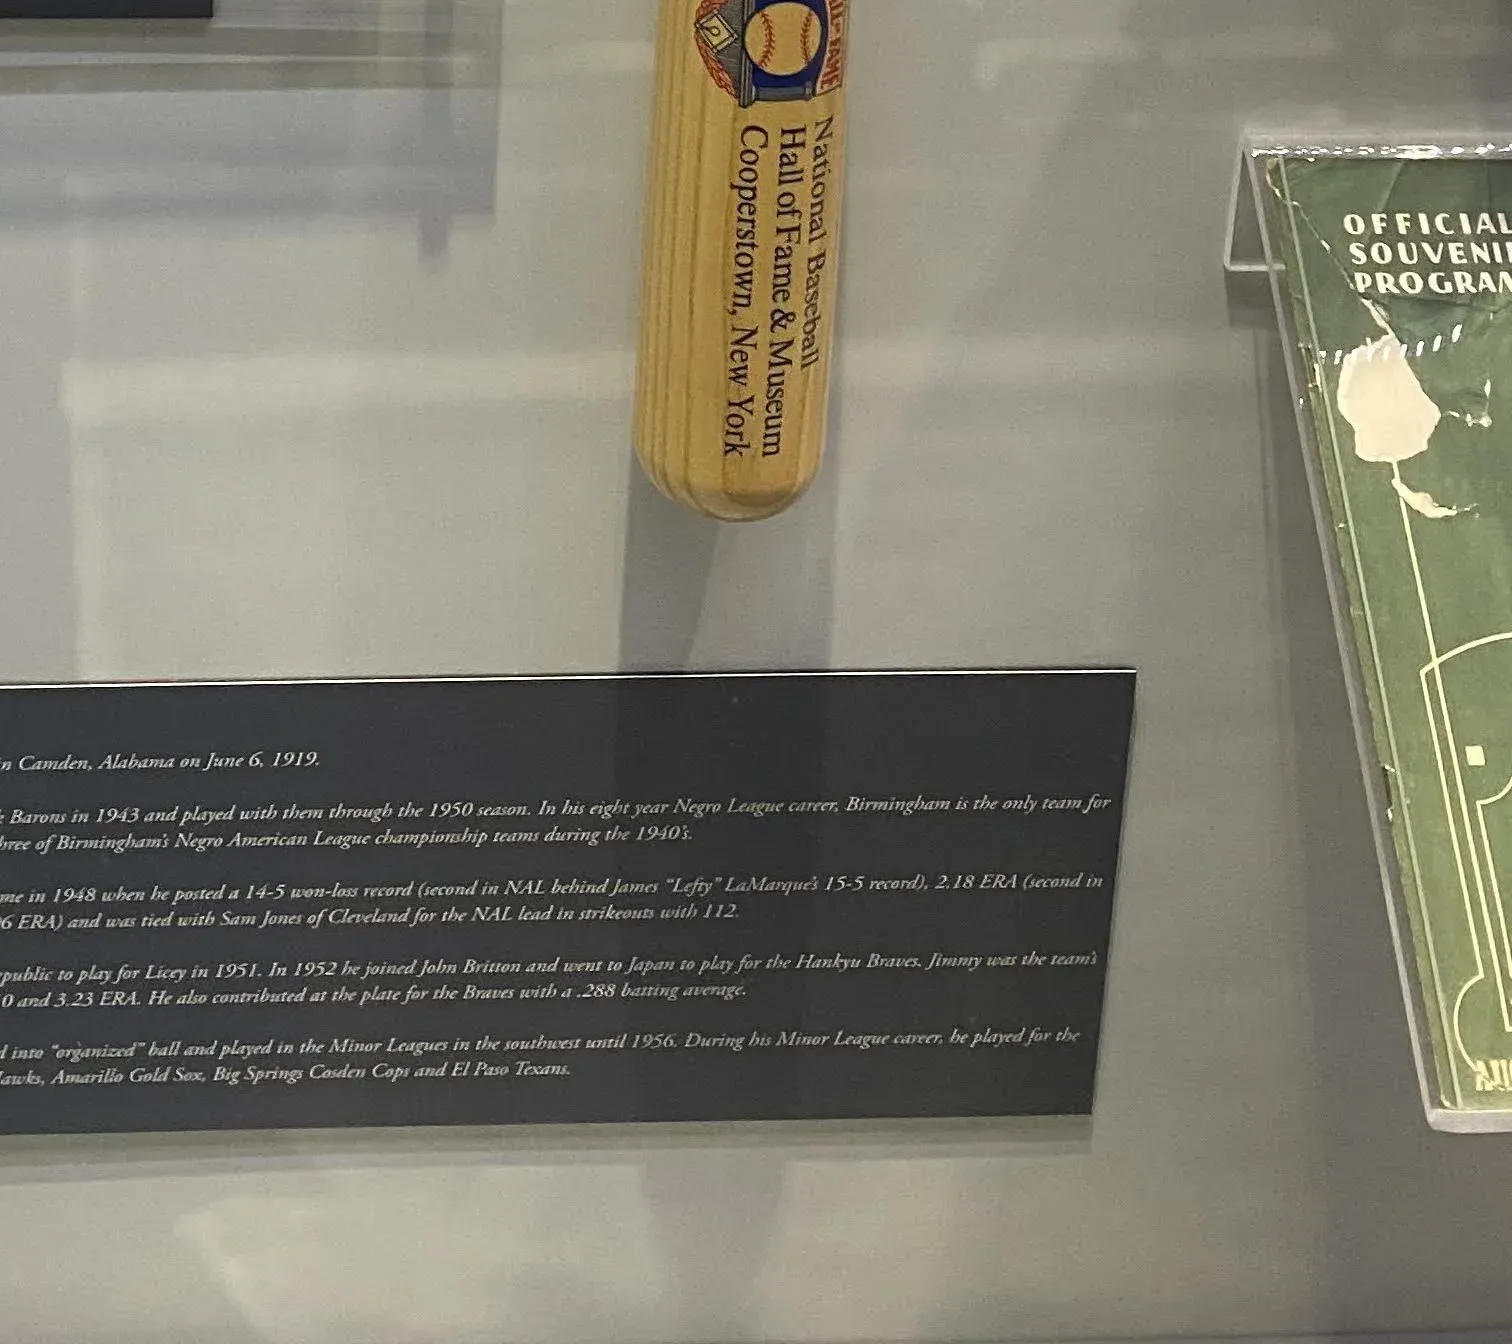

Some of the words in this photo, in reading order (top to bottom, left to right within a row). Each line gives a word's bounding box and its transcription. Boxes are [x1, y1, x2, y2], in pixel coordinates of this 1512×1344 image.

[780, 126, 807, 184] Hall
[808, 113, 835, 240] National
[731, 125, 768, 318] Cooperstown,
[781, 191, 801, 218] of
[1343, 213, 1512, 235] OFFICIAL
[773, 224, 801, 303] Fame
[771, 311, 791, 332] &
[799, 251, 825, 369] Baseball
[729, 328, 758, 389] New
[725, 396, 754, 457] York
[762, 338, 792, 457] Museum
[19, 754, 92, 772] Camden,
[98, 754, 173, 769] Alabama
[180, 757, 201, 769] on
[202, 752, 244, 771] June
[249, 751, 264, 769] 6,
[272, 751, 319, 768] 1919.
[10, 809, 67, 825] Barons
[71, 809, 88, 824] in
[95, 807, 140, 824] 1943
[144, 807, 179, 822] and
[180, 806, 236, 825] played
[240, 805, 277, 821] with
[282, 804, 323, 820] them
[329, 803, 393, 823] through
[398, 802, 423, 817] the
[429, 802, 473, 817] 1950
[476, 803, 531, 816] season.
[538, 801, 556, 816] In
[562, 799, 584, 815] his
[590, 799, 631, 819] eight
[634, 803, 669, 819] year
[672, 799, 721, 818] Negro
[728, 798, 784, 817] League
[845, 796, 950, 815] Birmingham
[956, 796, 968, 811] is
[973, 796, 998, 811] the
[1002, 794, 1038, 814] only
[1043, 797, 1081, 810] team
[1082, 793, 1112, 815] for
